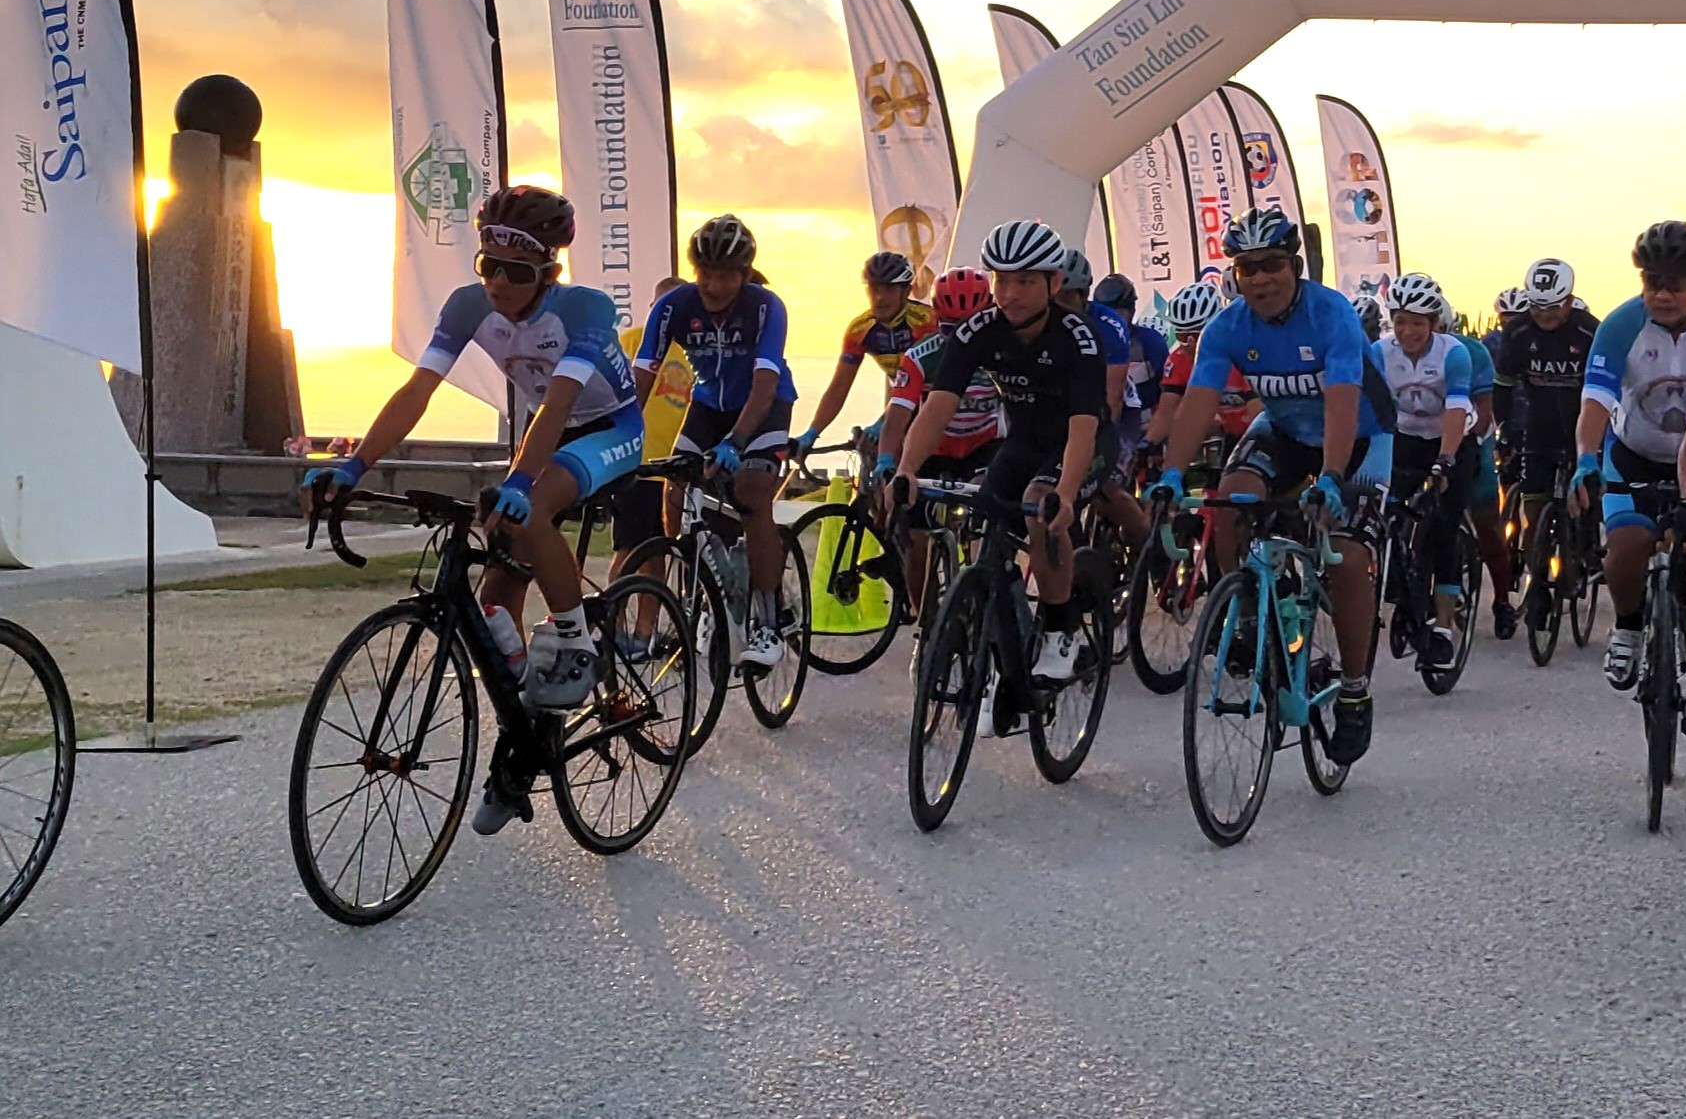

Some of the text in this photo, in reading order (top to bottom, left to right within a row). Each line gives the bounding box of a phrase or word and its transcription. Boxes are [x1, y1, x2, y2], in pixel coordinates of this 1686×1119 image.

[77, 27, 86, 50] THE
[1076, 37, 1119, 74] Tan
[1116, 17, 1151, 48] Siu
[1094, 19, 1211, 107] Foundation
[595, 44, 630, 214] Foundation
[1209, 131, 1233, 227] viation
[1149, 181, 1167, 239] (Saipan)
[1202, 195, 1225, 260] POI
[601, 222, 630, 274] Lin
[1150, 238, 1172, 282] L&T
[1530, 358, 1581, 374] NAVY
[599, 432, 645, 466] NMIC
